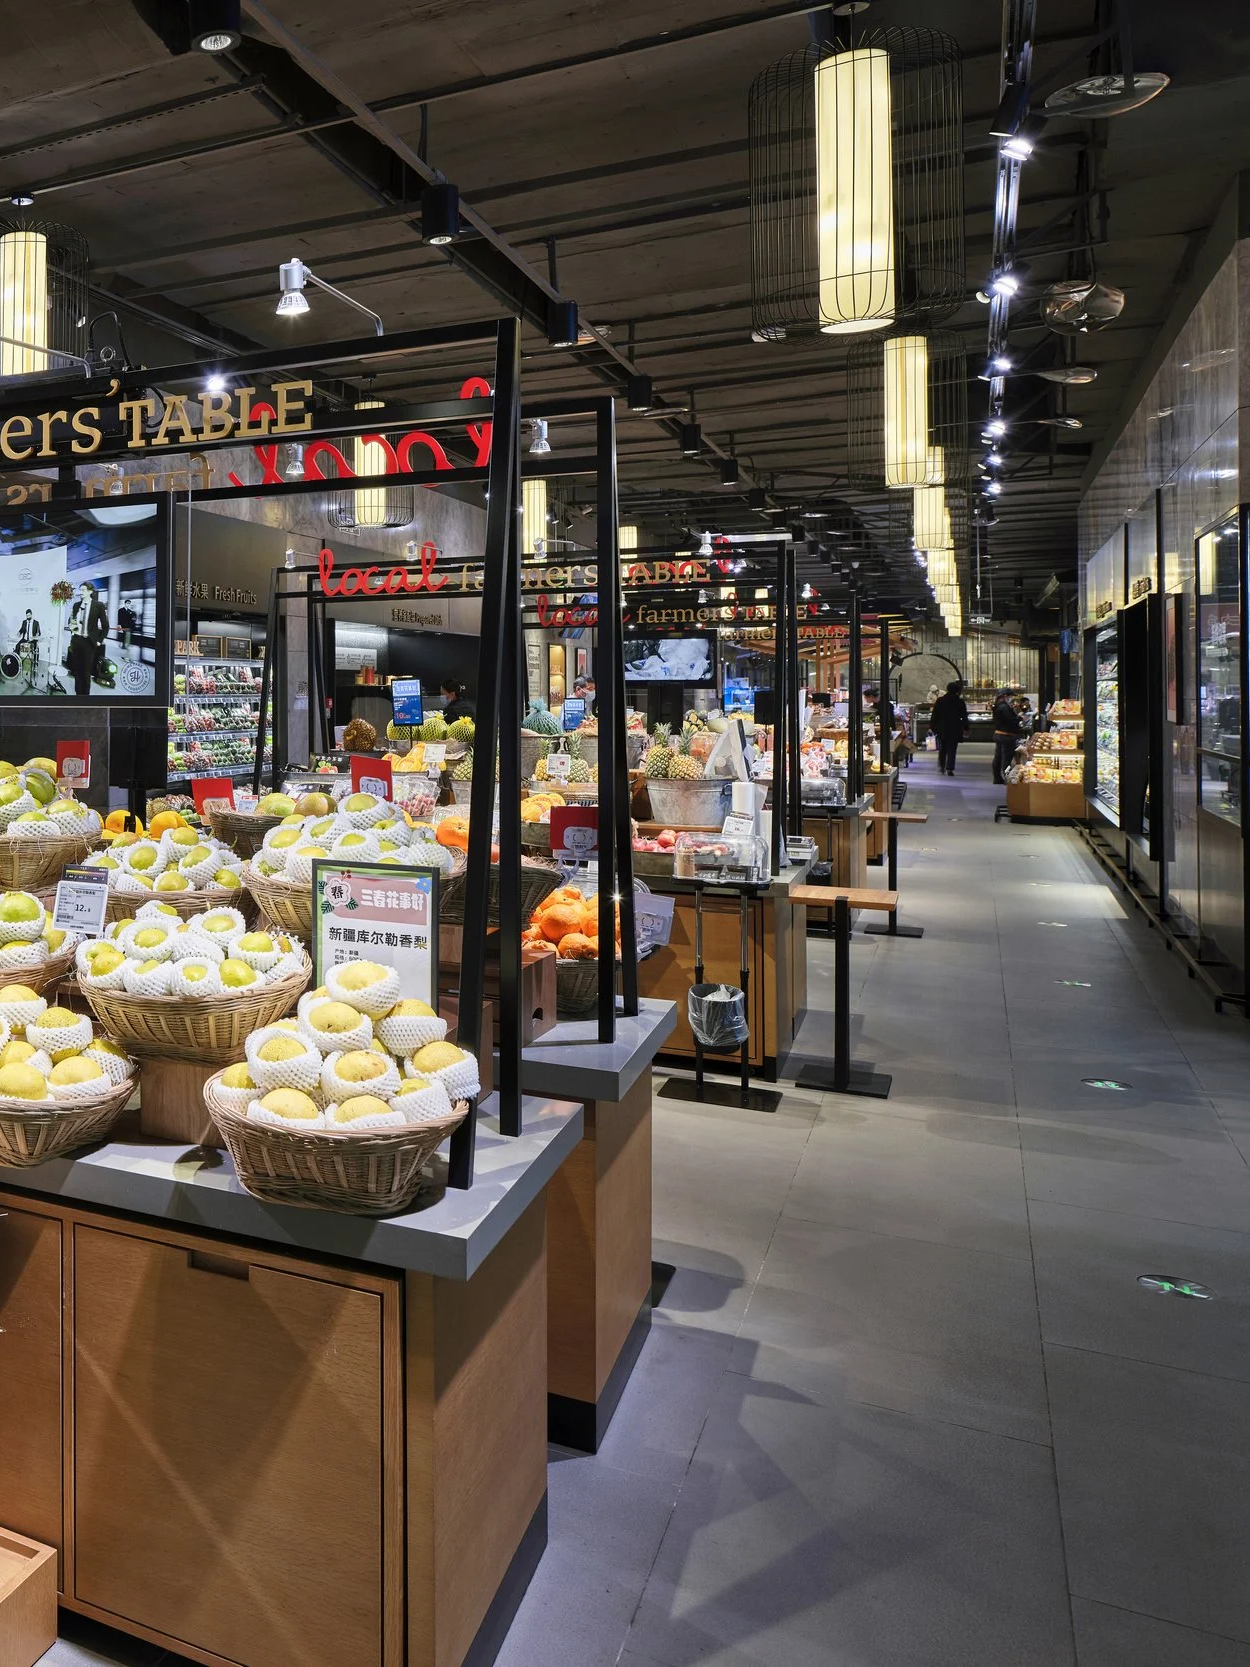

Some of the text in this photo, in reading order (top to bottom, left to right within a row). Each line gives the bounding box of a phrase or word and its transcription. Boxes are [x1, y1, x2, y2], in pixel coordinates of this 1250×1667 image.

[119, 380, 312, 448] TABLE
[319, 541, 449, 596] local
[176, 579, 257, 605] 新鲜水果 Fresh Fruits
[361, 889, 424, 911] 三春花事好
[329, 927, 428, 950] 新疆库尔勒香梨
